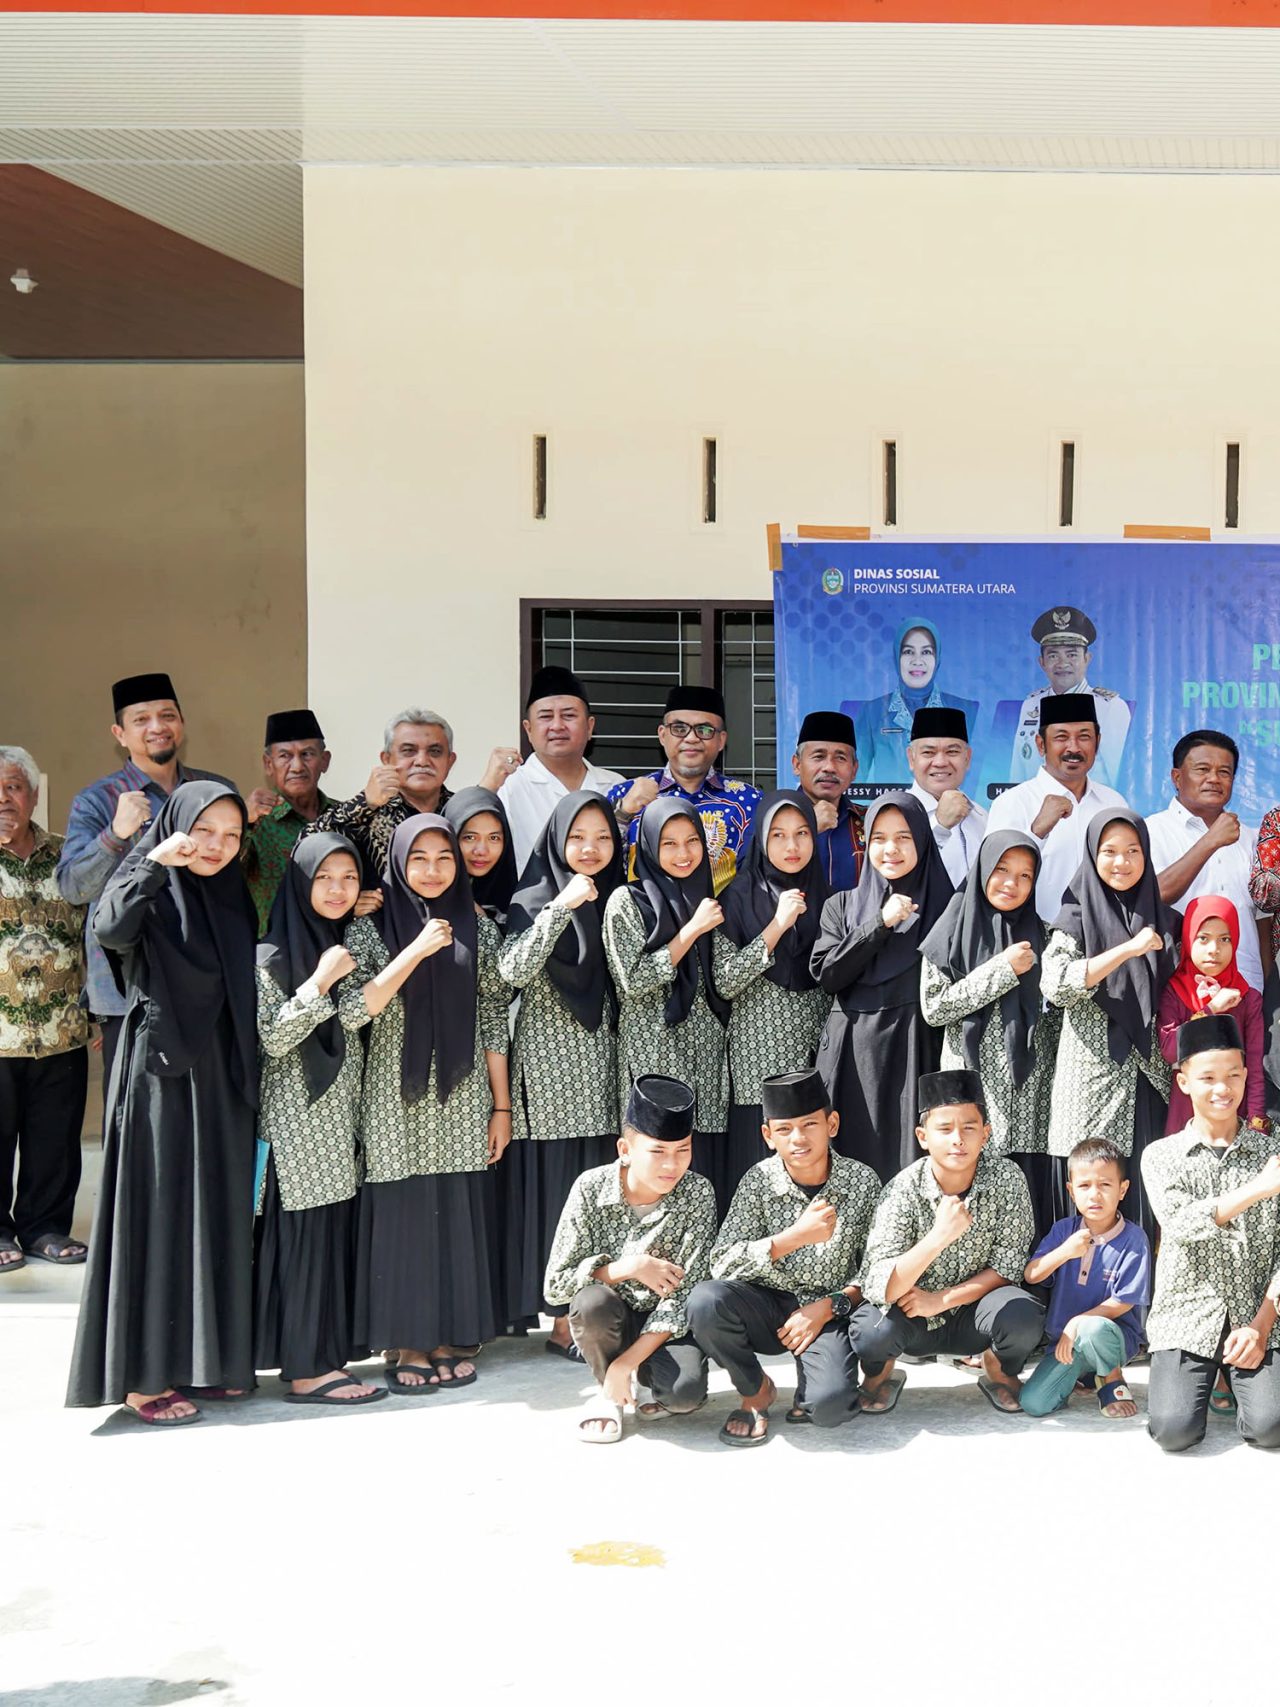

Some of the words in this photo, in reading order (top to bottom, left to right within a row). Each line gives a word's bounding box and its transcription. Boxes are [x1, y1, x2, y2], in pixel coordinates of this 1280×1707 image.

[854, 569, 893, 579] DINAS
[896, 569, 940, 579] SOSIAL
[854, 583, 908, 594] PROVINSI
[911, 583, 974, 594] SUMATERA
[977, 584, 1016, 594] UTARA
